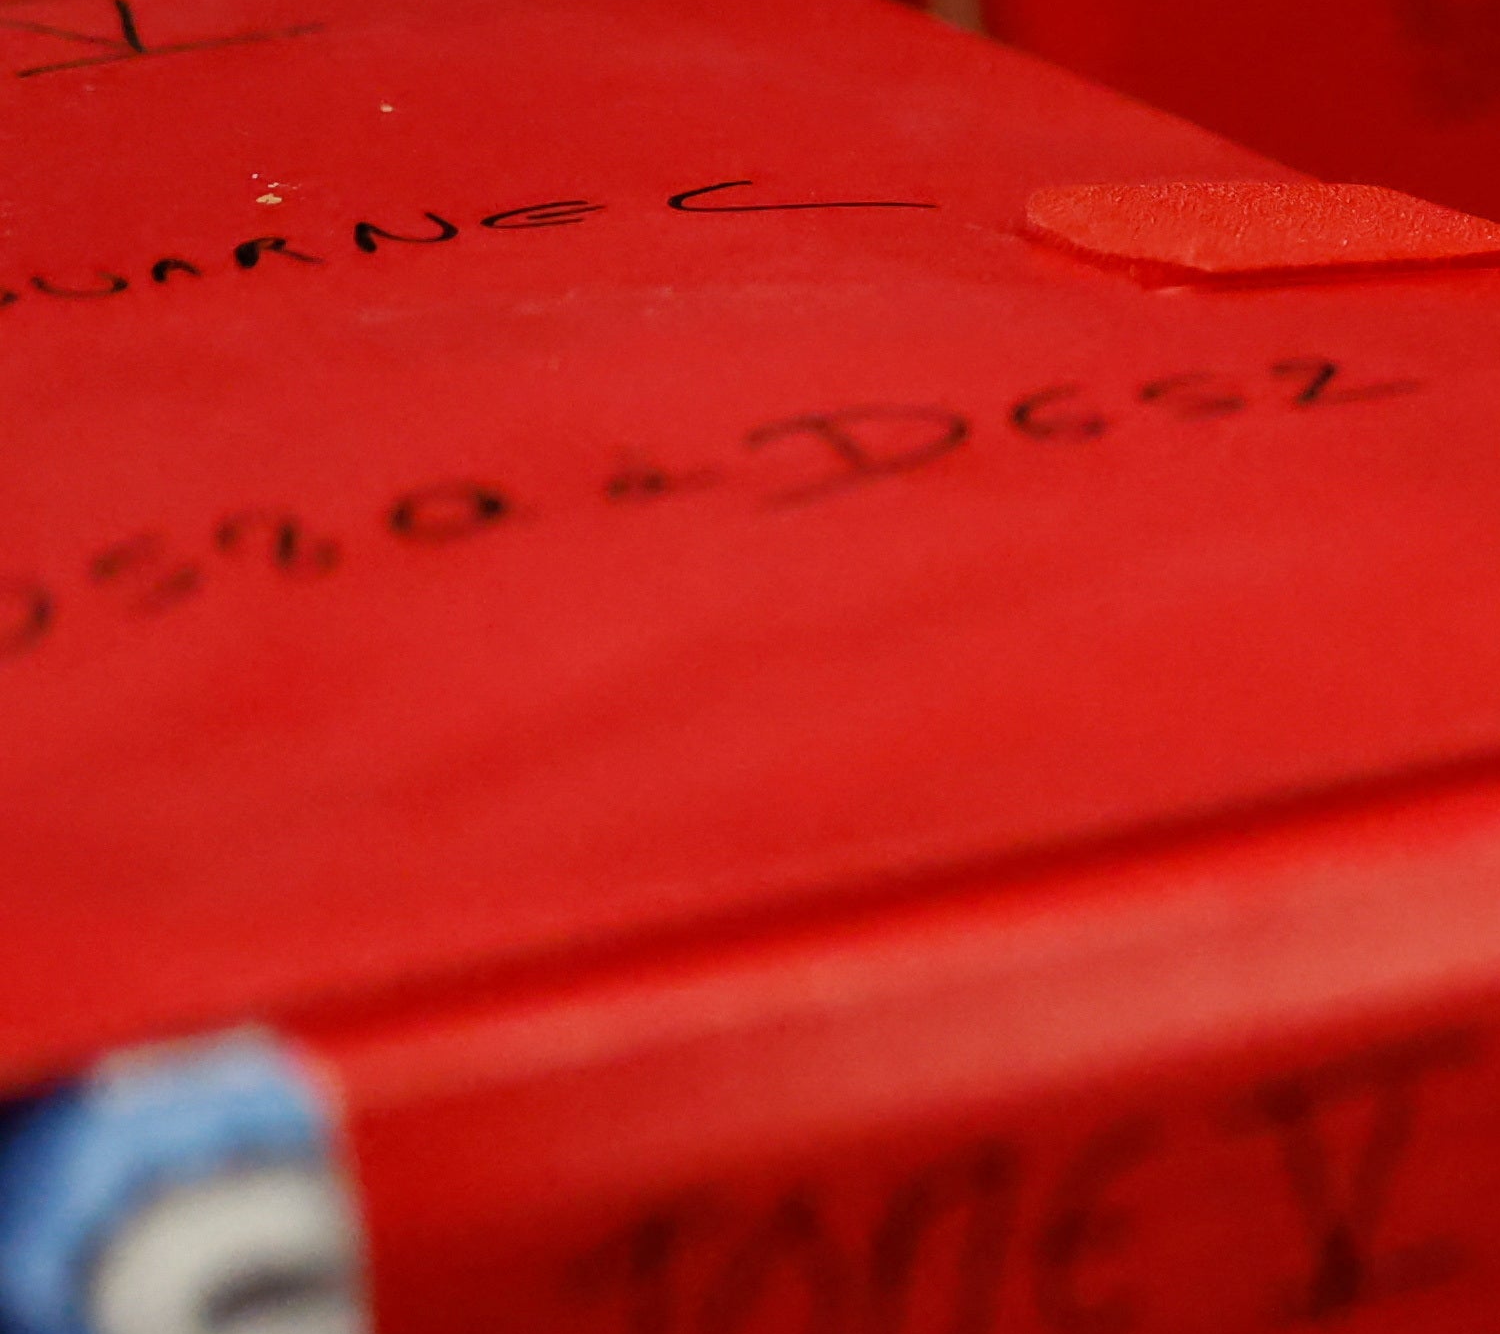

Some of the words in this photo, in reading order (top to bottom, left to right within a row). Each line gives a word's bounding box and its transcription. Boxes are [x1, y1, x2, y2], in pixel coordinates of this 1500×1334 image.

[0, 180, 938, 309] UARNEC
[740, 357, 1425, 517] D652
[1210, 1020, 1488, 1329] V
